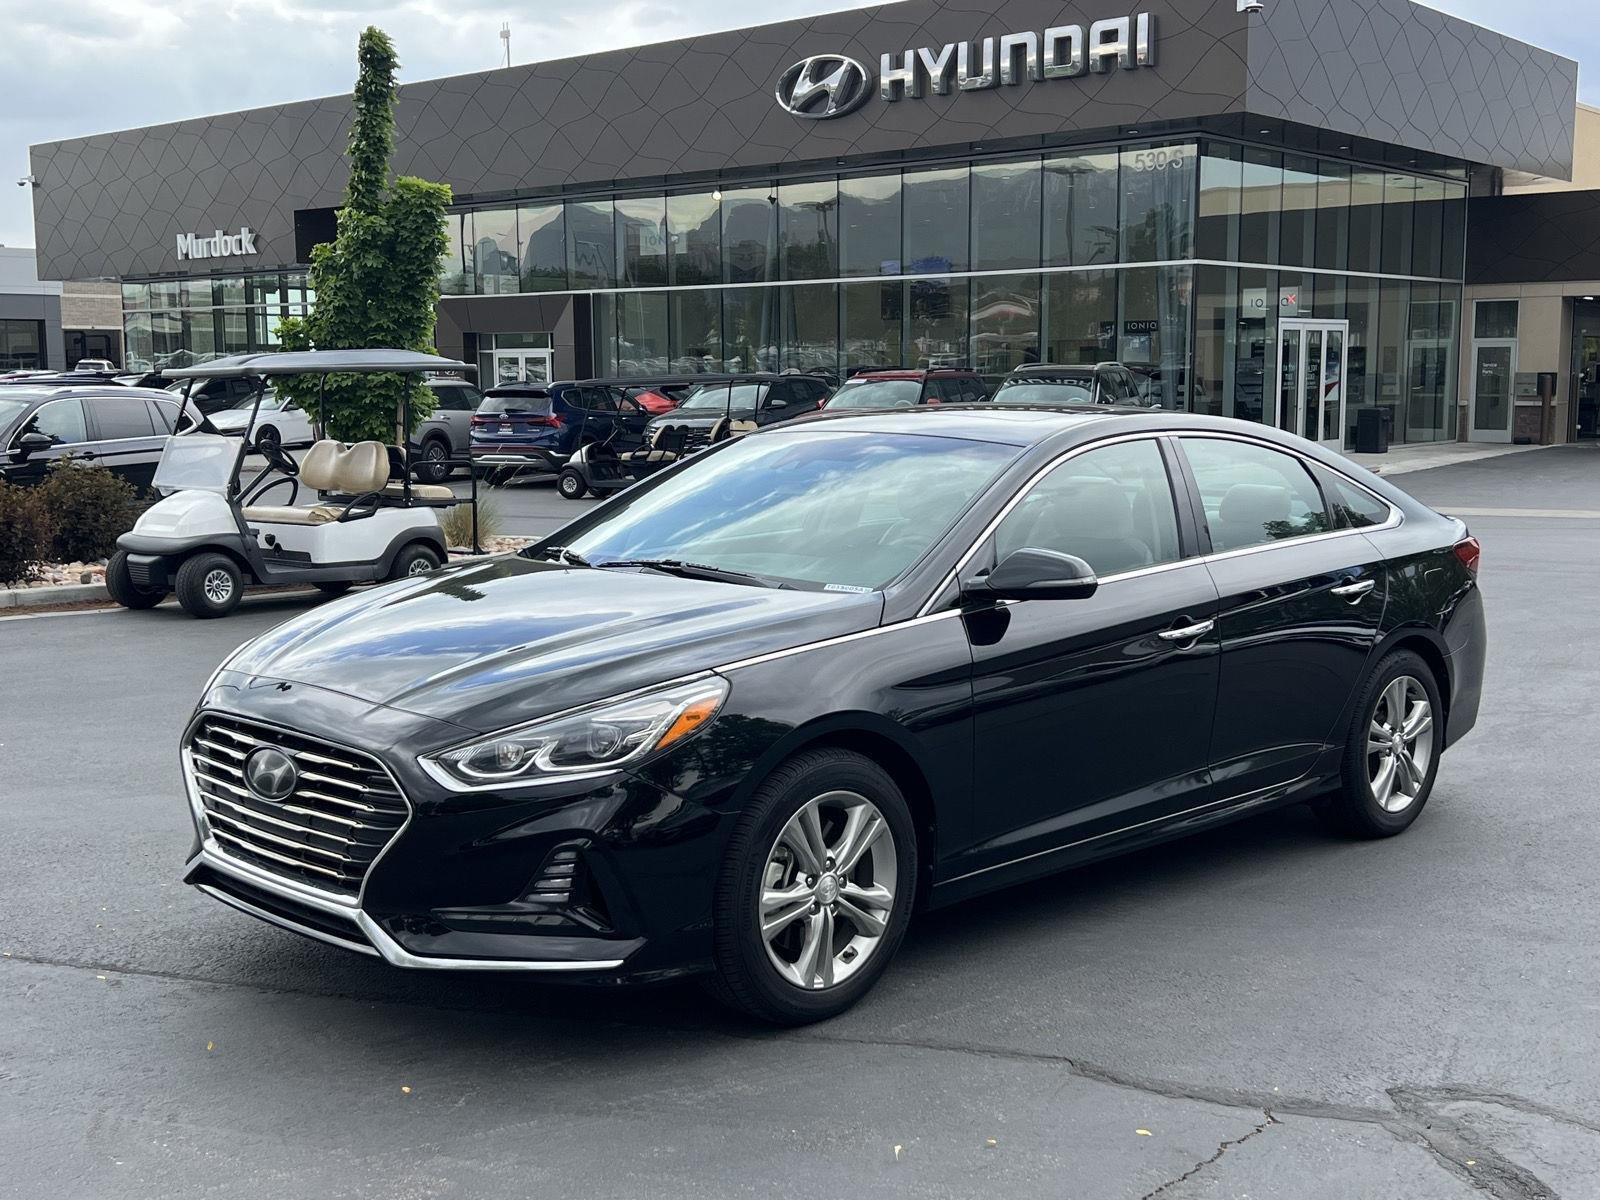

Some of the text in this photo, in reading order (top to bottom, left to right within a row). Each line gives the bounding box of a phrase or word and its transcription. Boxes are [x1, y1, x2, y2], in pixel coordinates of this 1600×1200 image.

[880, 12, 1155, 101] HYUNDAI
[1134, 149, 1184, 172] 530 S
[176, 227, 257, 260] Murdock
